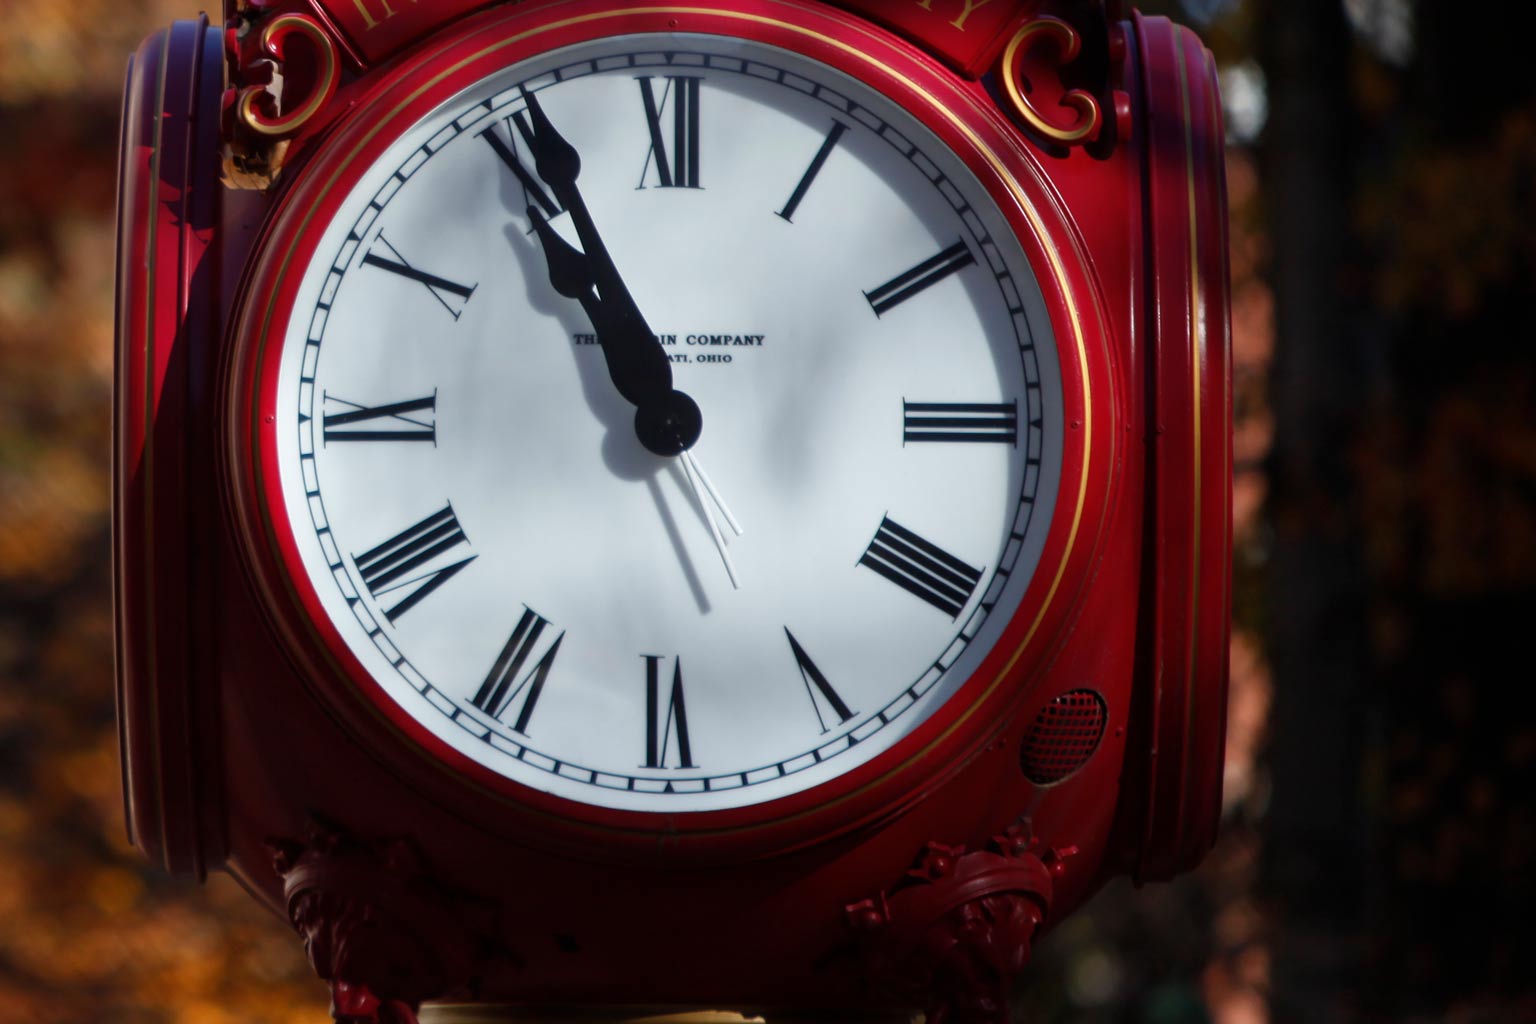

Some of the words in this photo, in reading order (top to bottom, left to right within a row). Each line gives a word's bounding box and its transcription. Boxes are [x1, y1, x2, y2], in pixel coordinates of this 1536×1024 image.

[633, 76, 706, 189] XII
[774, 117, 850, 223] I
[360, 228, 479, 322] X
[862, 235, 977, 319] II
[686, 334, 765, 346] COMPANY
[696, 354, 733, 363] OHIO
[902, 397, 1018, 448] III
[350, 498, 479, 629] VIII
[855, 510, 986, 623] IIII
[463, 603, 566, 737] VII
[637, 654, 700, 769] VI
[783, 625, 860, 735] V
